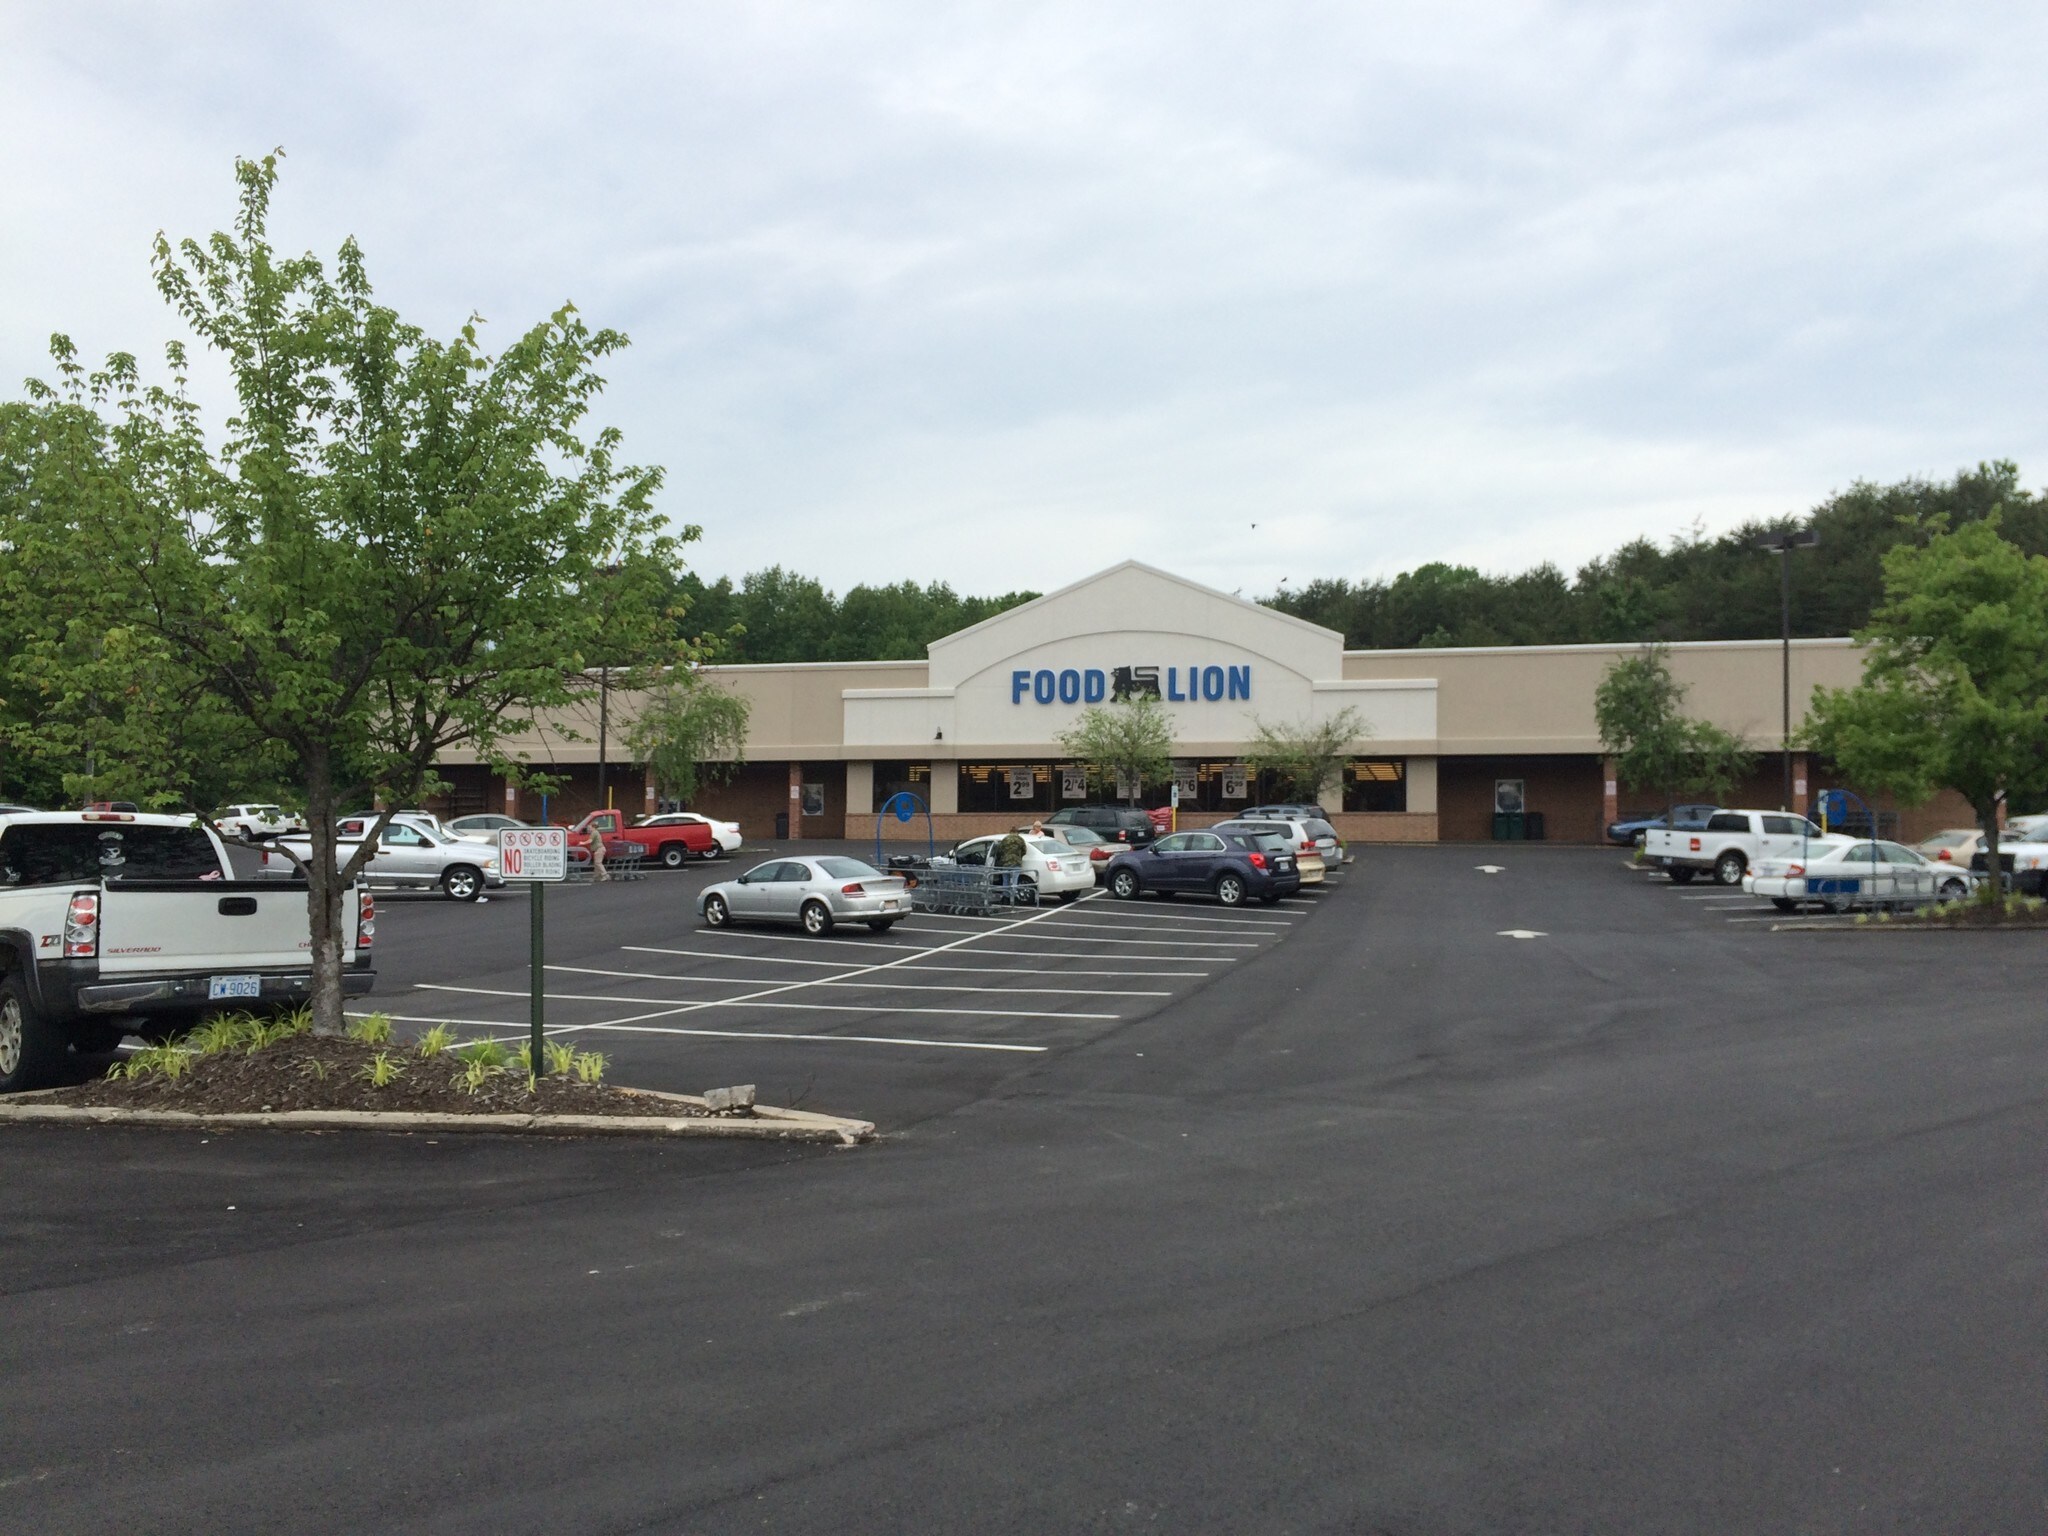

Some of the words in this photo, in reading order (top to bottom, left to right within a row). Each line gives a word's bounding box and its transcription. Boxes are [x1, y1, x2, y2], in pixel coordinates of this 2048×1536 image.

[1011, 668, 1106, 704] FOOD
[1167, 665, 1251, 702] LION
[505, 849, 522, 874] NO
[106, 946, 162, 954] SILVERADO
